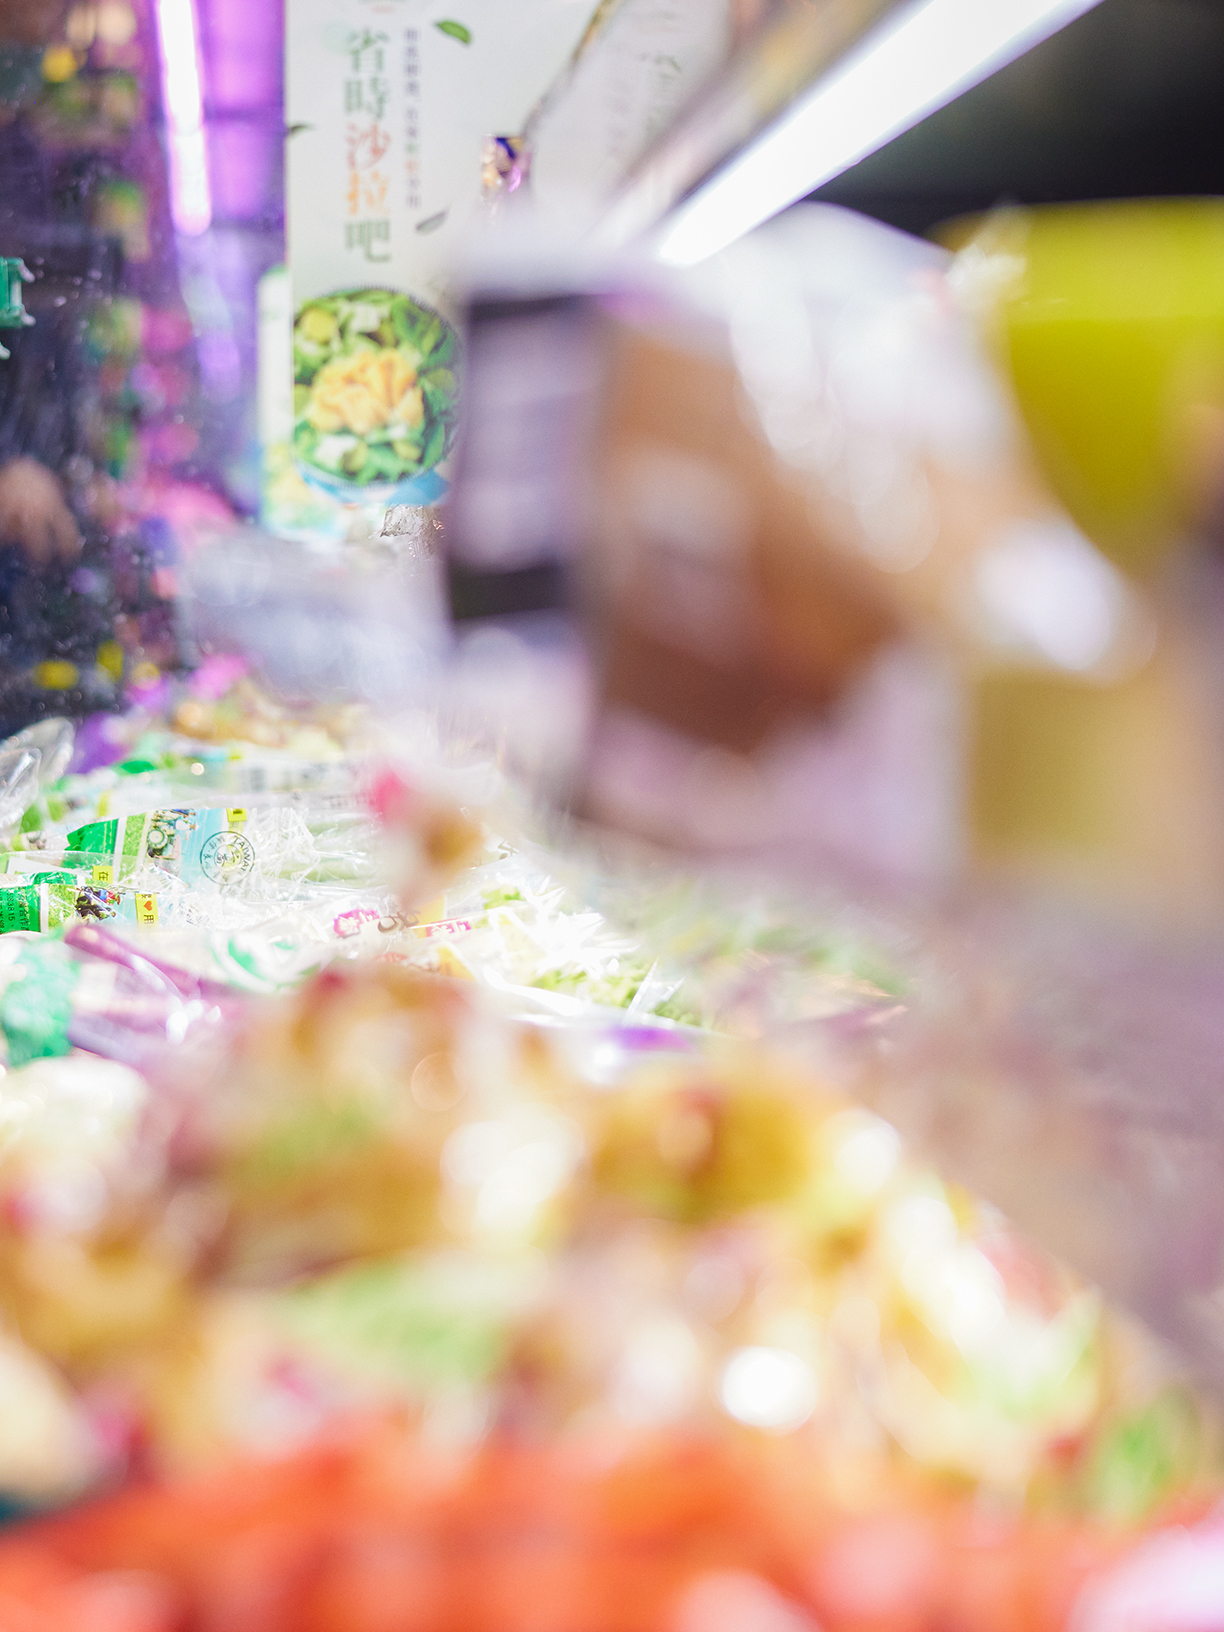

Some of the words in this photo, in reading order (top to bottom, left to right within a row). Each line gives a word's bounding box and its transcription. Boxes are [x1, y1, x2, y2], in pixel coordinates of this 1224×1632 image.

[343, 28, 392, 263] 省時沙拉吧
